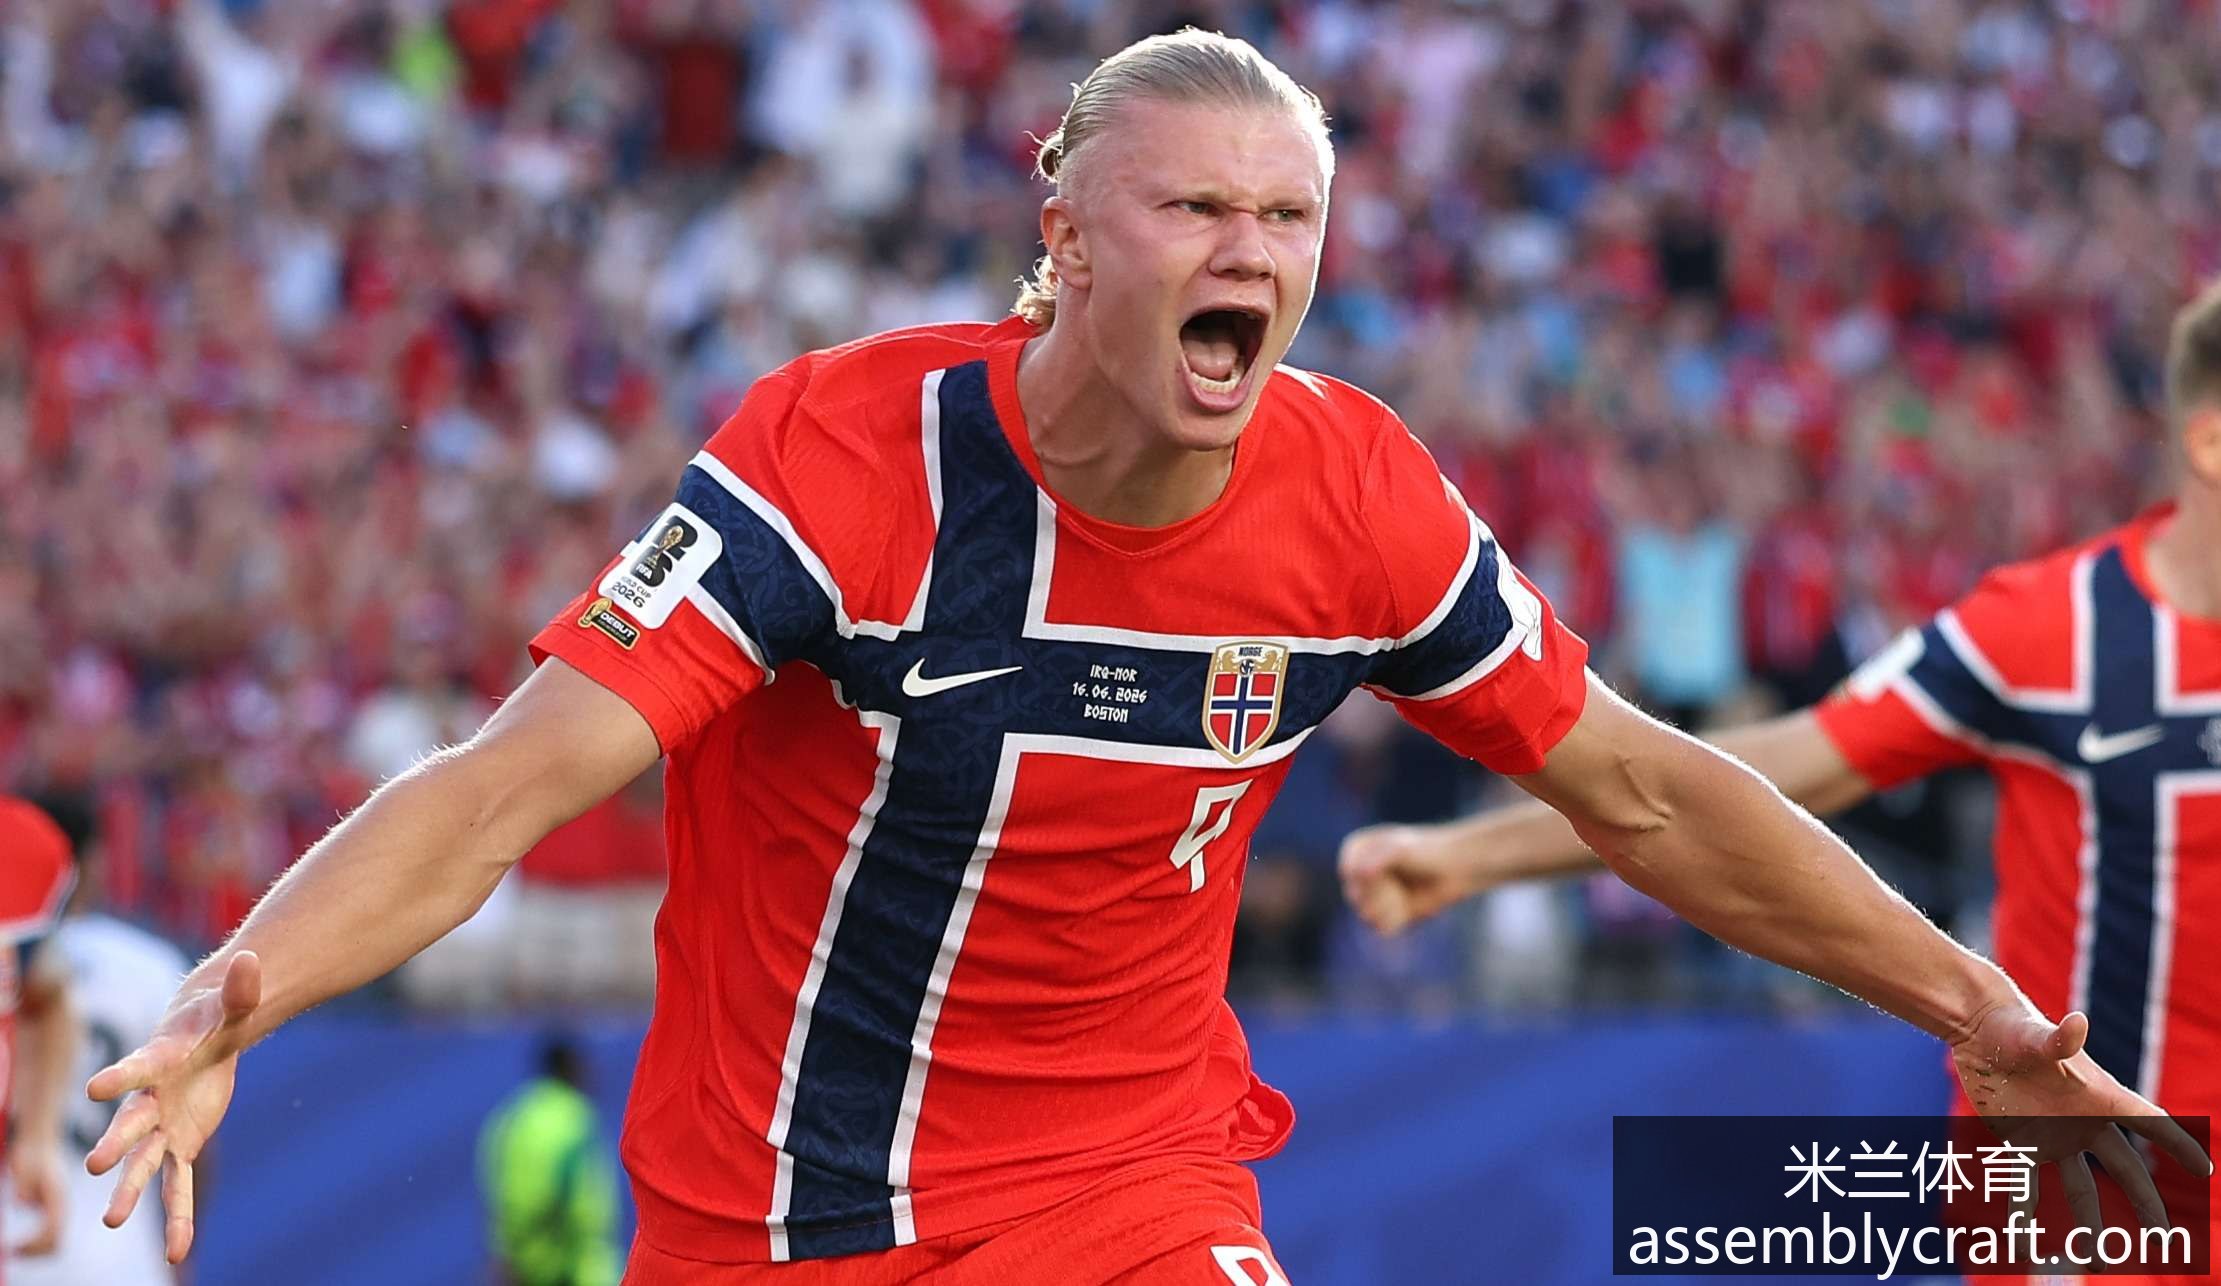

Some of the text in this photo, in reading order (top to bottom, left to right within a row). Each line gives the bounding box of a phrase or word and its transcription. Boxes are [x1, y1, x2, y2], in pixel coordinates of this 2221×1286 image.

[635, 563, 653, 580] FIFA
[612, 582, 646, 608] 2026
[636, 585, 652, 598] CUP
[600, 612, 635, 638] DEBUT
[1090, 664, 1138, 682] IRQ-NOR
[1083, 703, 1129, 723] BOSTON
[1169, 778, 1254, 894] 9
